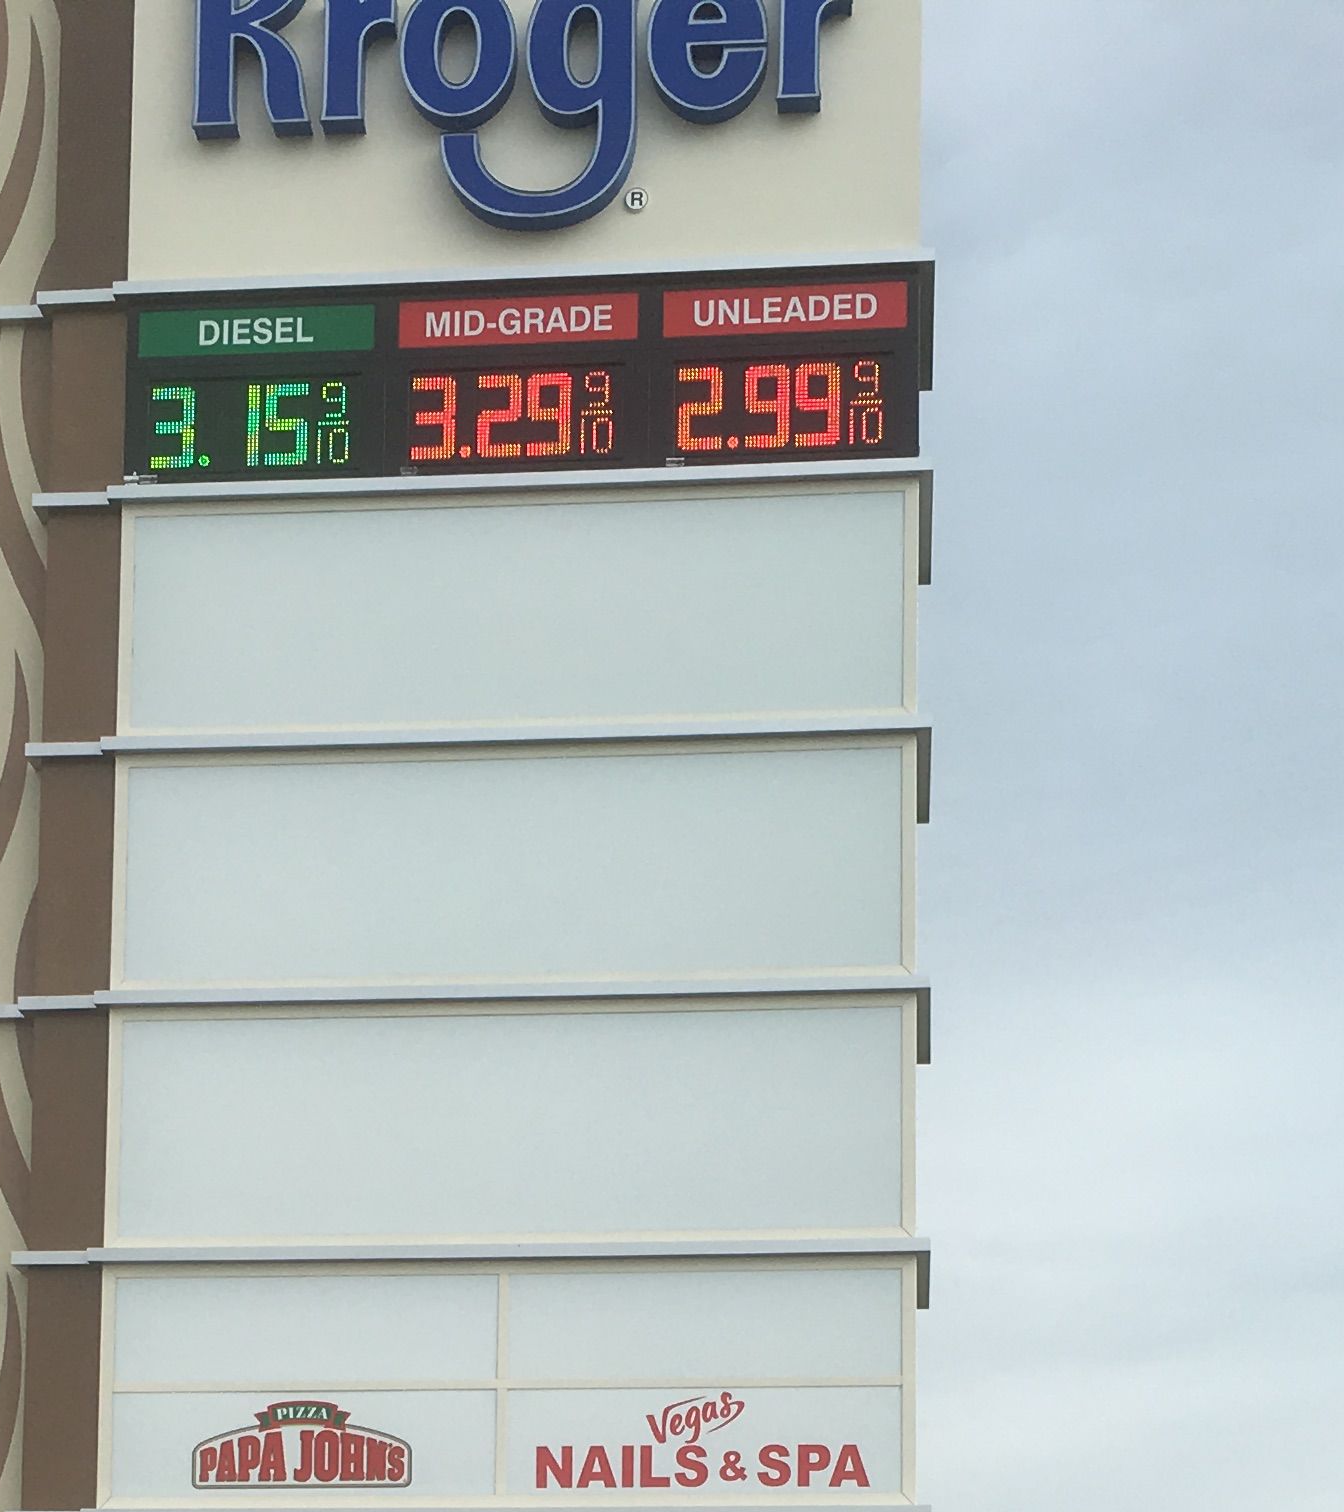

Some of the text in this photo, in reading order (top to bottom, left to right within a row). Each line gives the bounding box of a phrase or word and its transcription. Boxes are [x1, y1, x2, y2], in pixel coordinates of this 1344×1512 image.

[192, 0, 854, 231] Kroger
[198, 317, 314, 346] DIESEL
[425, 304, 613, 338] MID-GRADE
[693, 292, 878, 327] UNLEADED
[150, 382, 310, 469] 3.15
[410, 371, 572, 460] 3.29
[677, 362, 841, 450] 2.99
[276, 1407, 328, 1421] PIZZA
[645, 1391, 745, 1444] Vegas
[199, 1430, 405, 1482] PAPA JOHN'S
[535, 1444, 871, 1488] NAILS & SPA
